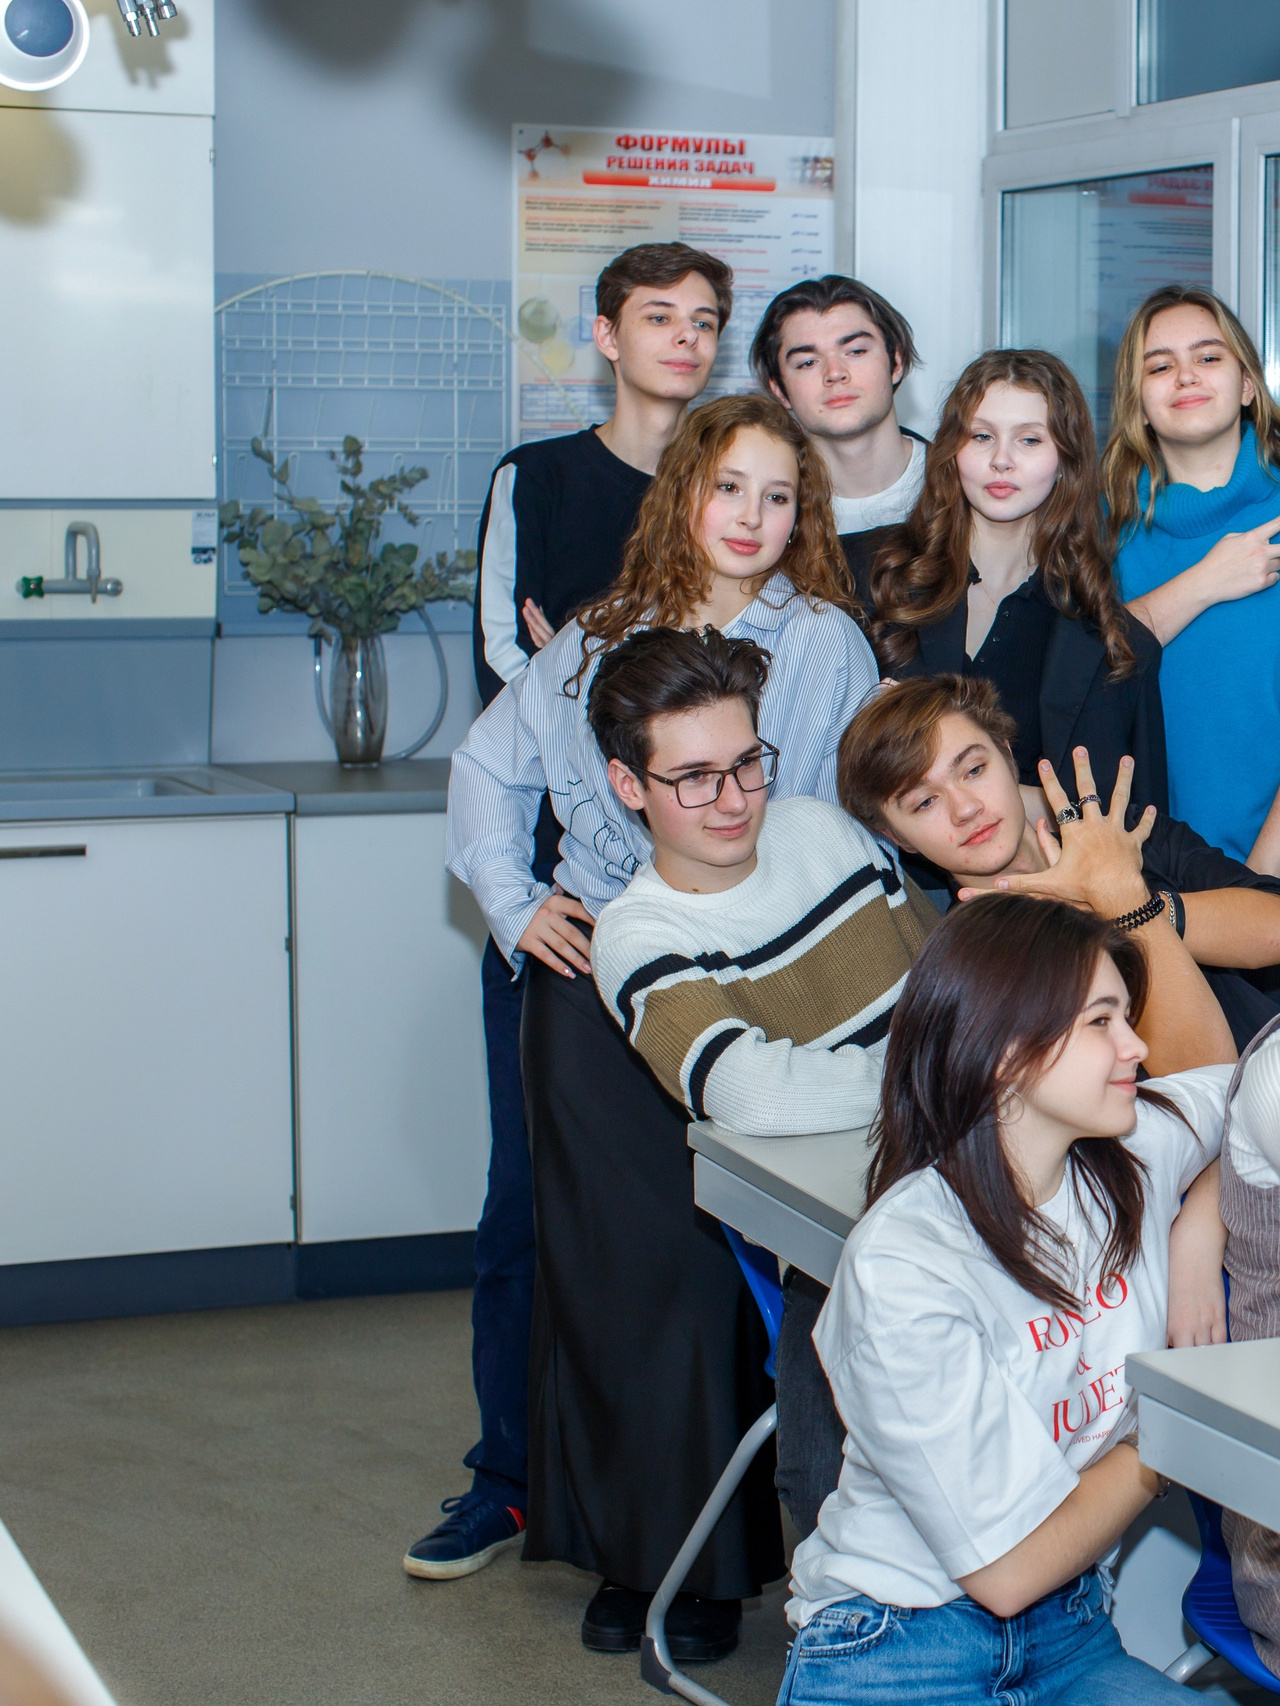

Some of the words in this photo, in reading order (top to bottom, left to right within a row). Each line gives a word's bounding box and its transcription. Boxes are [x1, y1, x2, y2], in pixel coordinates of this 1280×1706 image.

[616, 133, 746, 156] ФОРМУЛЫ
[606, 155, 689, 171] РЕШЕНИЯ
[694, 159, 755, 175] ЗАДАЧ
[648, 176, 712, 188] ХИМИЯ
[1076, 1351, 1093, 1376] &
